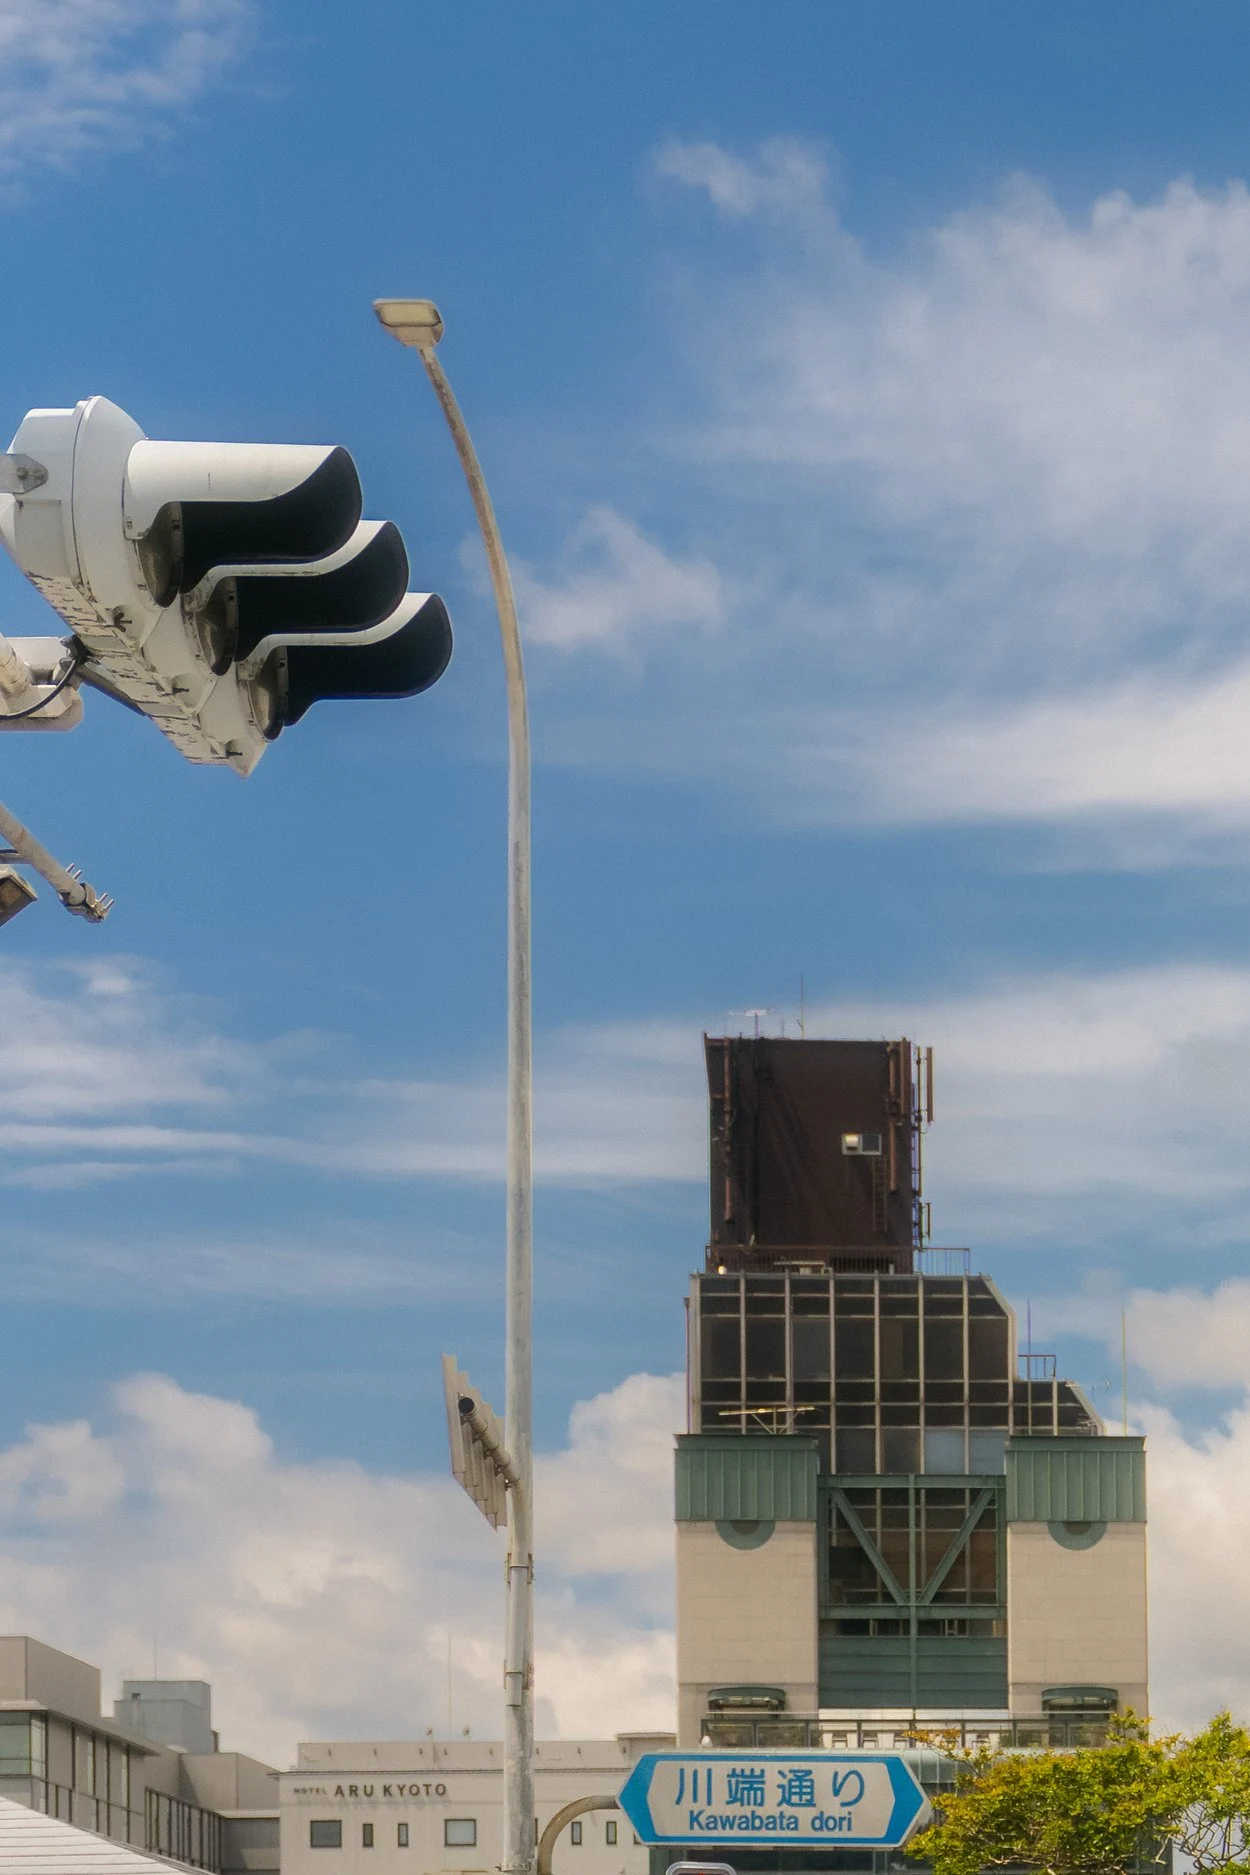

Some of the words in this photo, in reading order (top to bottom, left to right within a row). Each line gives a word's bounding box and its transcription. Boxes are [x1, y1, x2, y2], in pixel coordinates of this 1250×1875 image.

[293, 1787, 327, 1795] HOTEL
[334, 1784, 374, 1797] ARU
[383, 1783, 447, 1797] KYOTO
[675, 1767, 865, 1807] 川端通り
[689, 1809, 799, 1831] Kawabata
[811, 1811, 852, 1831] dori
